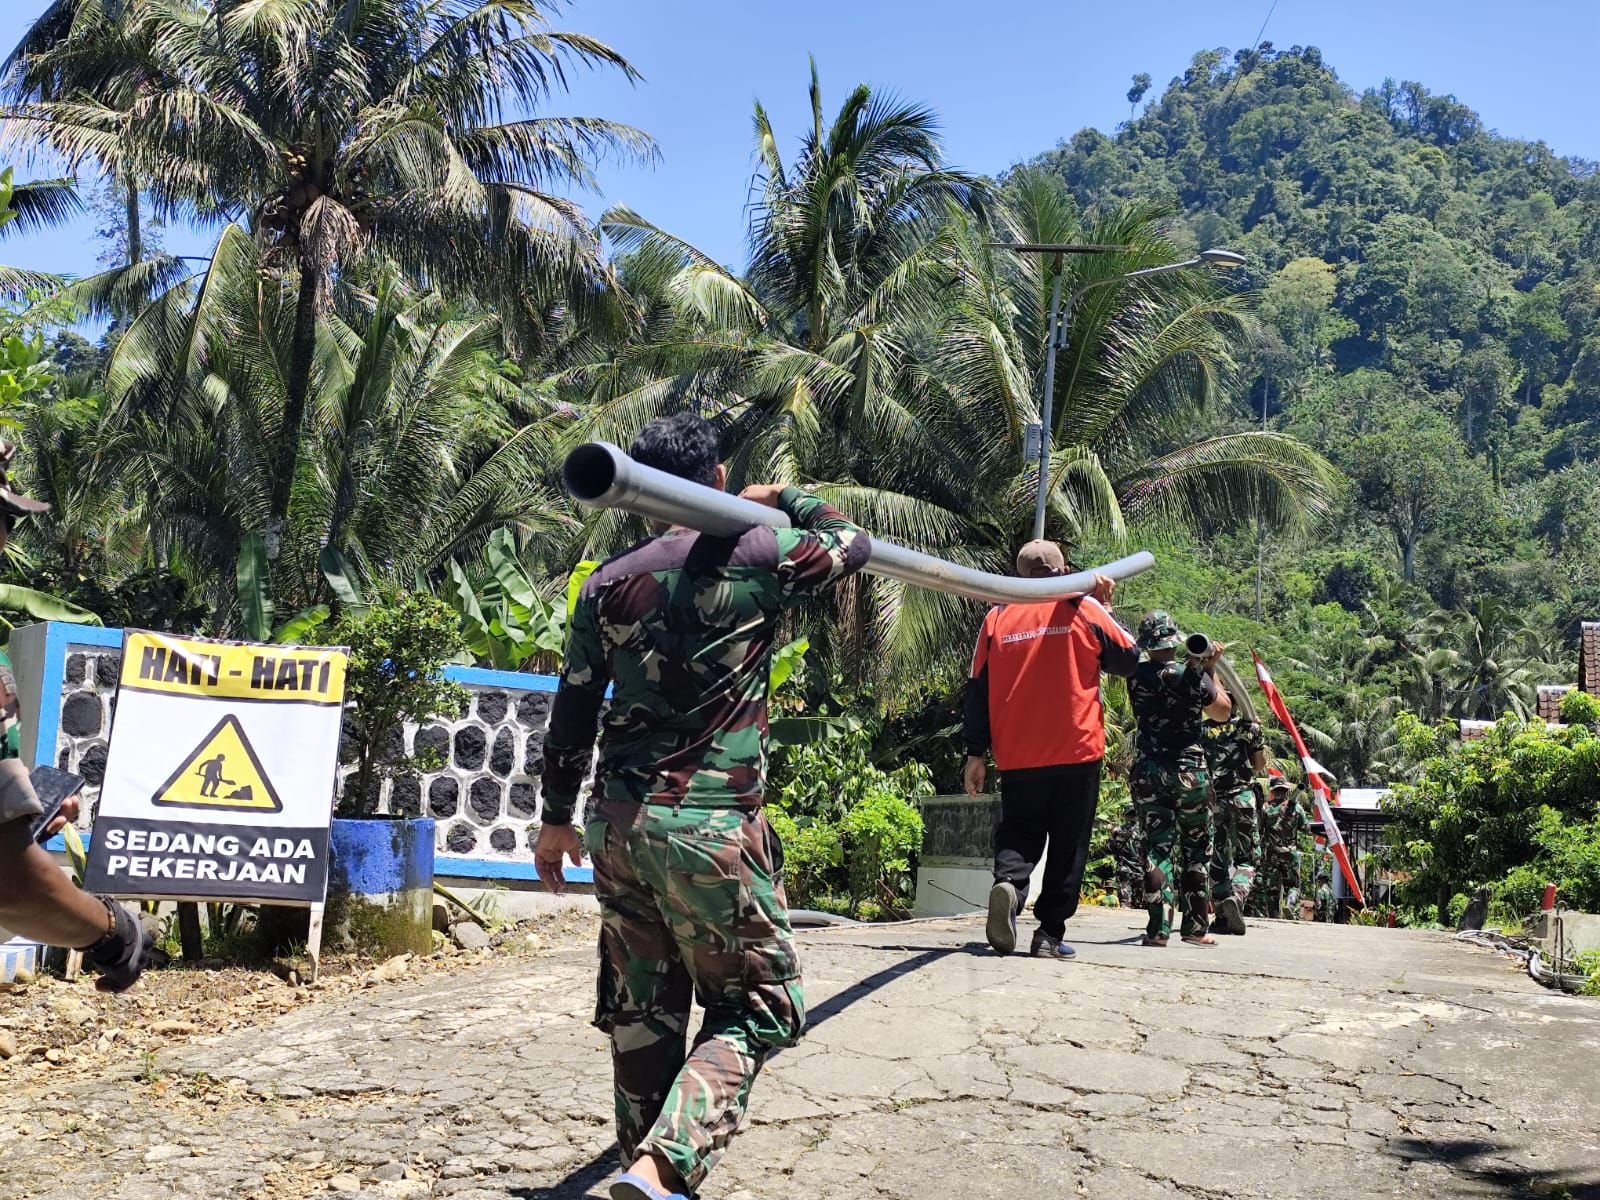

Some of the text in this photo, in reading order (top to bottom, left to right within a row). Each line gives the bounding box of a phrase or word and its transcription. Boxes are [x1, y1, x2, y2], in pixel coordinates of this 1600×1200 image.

[139, 646, 222, 686] HATI
[250, 655, 331, 694] HATI
[104, 829, 316, 859] SEDANG ADA
[106, 855, 306, 884] PEKERJAAN
